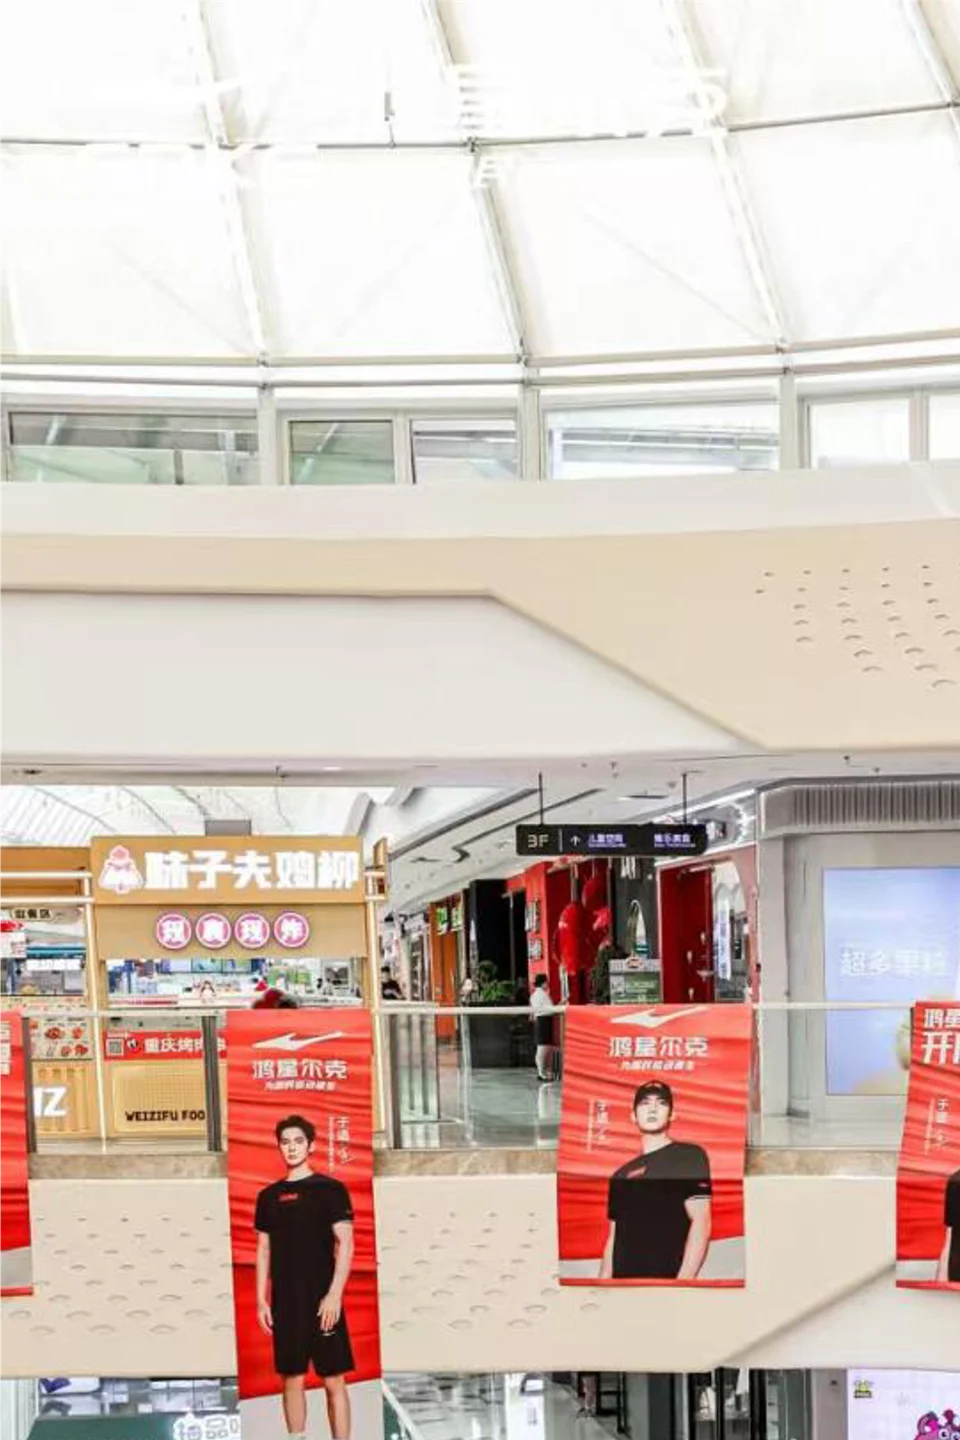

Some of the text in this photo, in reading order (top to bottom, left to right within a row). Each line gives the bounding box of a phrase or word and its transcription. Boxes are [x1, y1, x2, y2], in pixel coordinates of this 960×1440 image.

[527, 833, 549, 848] 3F
[609, 1036, 709, 1057] 鸿星尔克
[252, 1058, 348, 1079] 鸿星尔克
[125, 1110, 178, 1121] WEIZIFU
